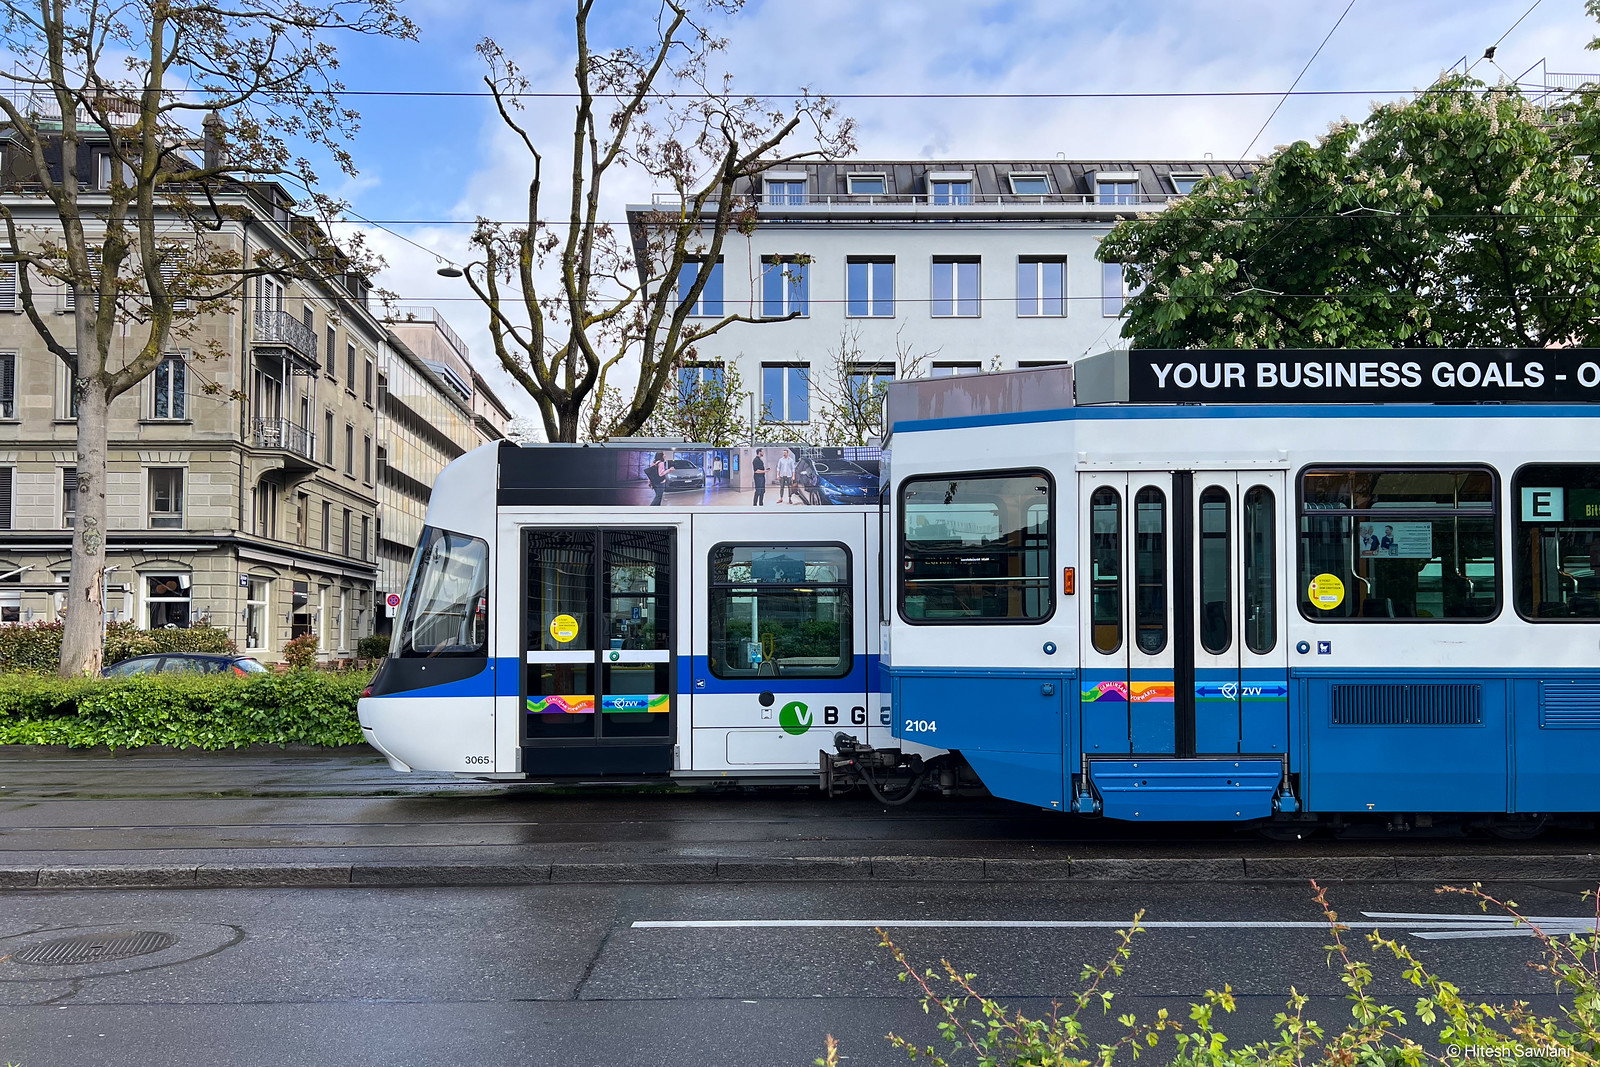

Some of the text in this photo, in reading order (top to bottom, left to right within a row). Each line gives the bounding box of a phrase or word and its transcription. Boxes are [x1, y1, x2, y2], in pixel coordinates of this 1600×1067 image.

[1150, 362, 1246, 388] YOUR
[1256, 361, 1422, 388] BUSINESS
[1431, 361, 1545, 388] GOALS
[1533, 492, 1552, 516] E
[1585, 504, 1600, 517] Bit
[1099, 681, 1128, 694] GEMEINSAM
[1242, 687, 1262, 696] ZVV
[905, 720, 937, 733] 2104
[465, 755, 490, 765] 3065
